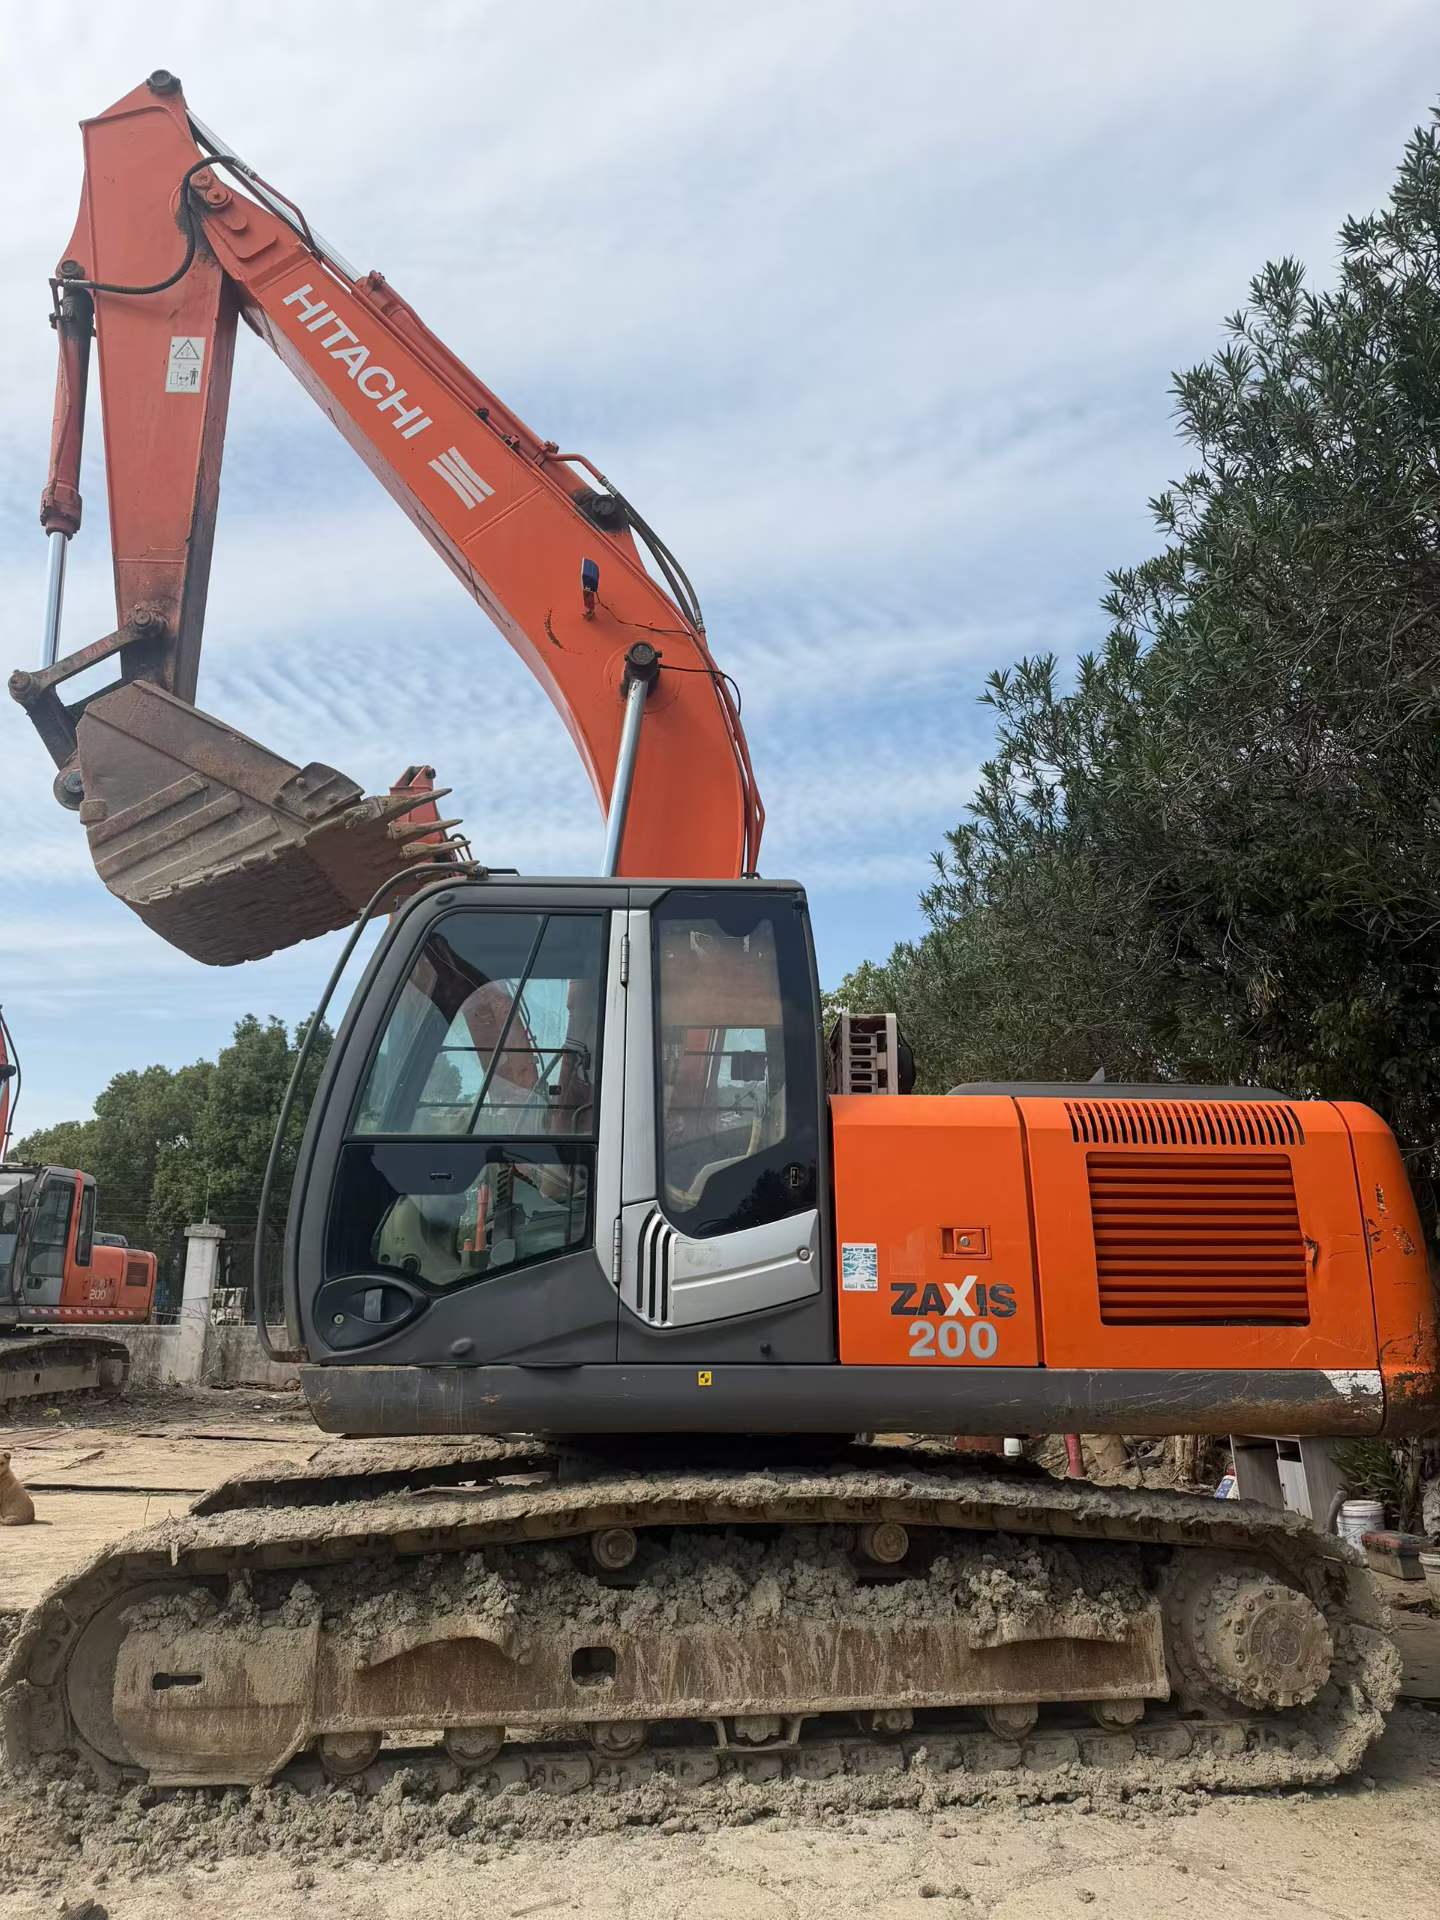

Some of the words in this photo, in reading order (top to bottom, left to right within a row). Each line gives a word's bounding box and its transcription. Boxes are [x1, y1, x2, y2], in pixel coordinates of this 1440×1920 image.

[282, 283, 433, 440] HITACHI
[90, 1288, 107, 1300] 200
[890, 1275, 1017, 1319] ZAXIS
[908, 1320, 998, 1359] 200
